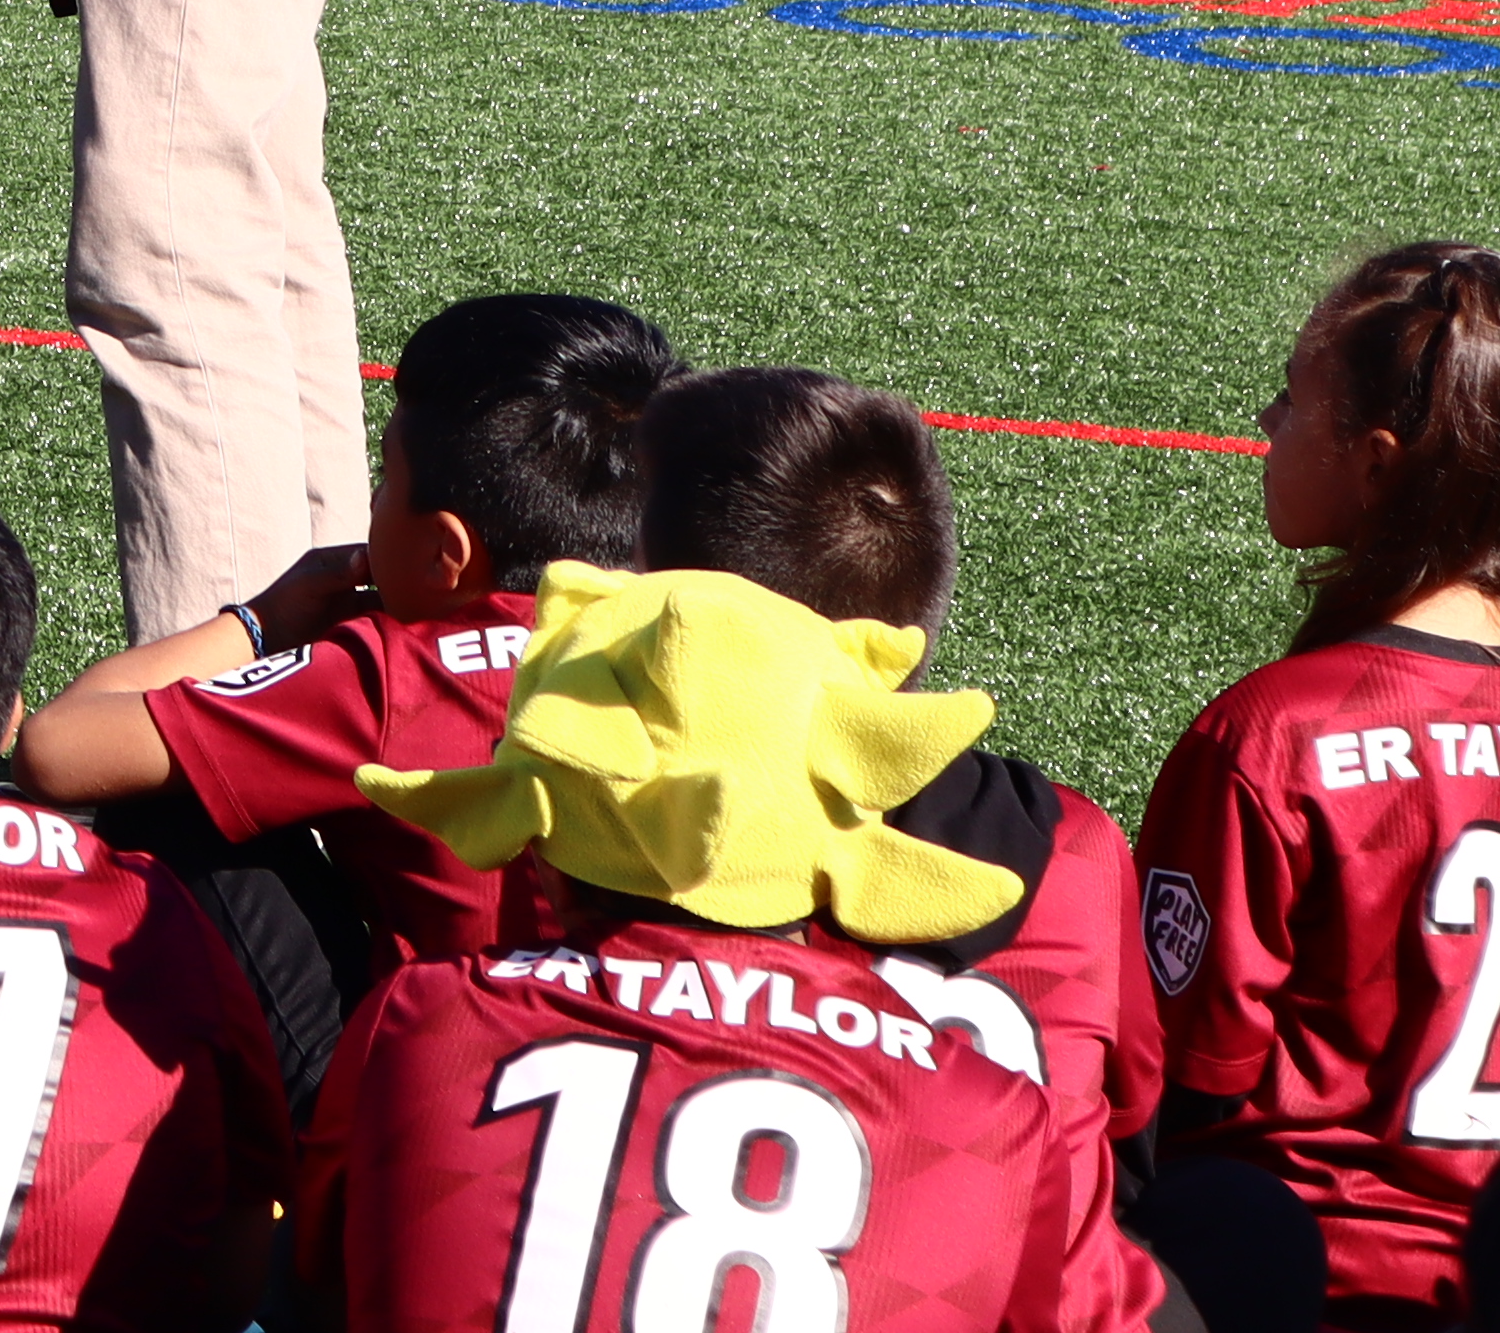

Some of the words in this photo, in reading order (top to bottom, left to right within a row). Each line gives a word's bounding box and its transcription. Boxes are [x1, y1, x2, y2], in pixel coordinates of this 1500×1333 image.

[1315, 726, 1420, 790] ER
[1154, 919, 1198, 970] FREE
[486, 944, 600, 996] ER
[603, 954, 939, 1073] TAYLOR
[472, 1033, 874, 1333] 18
